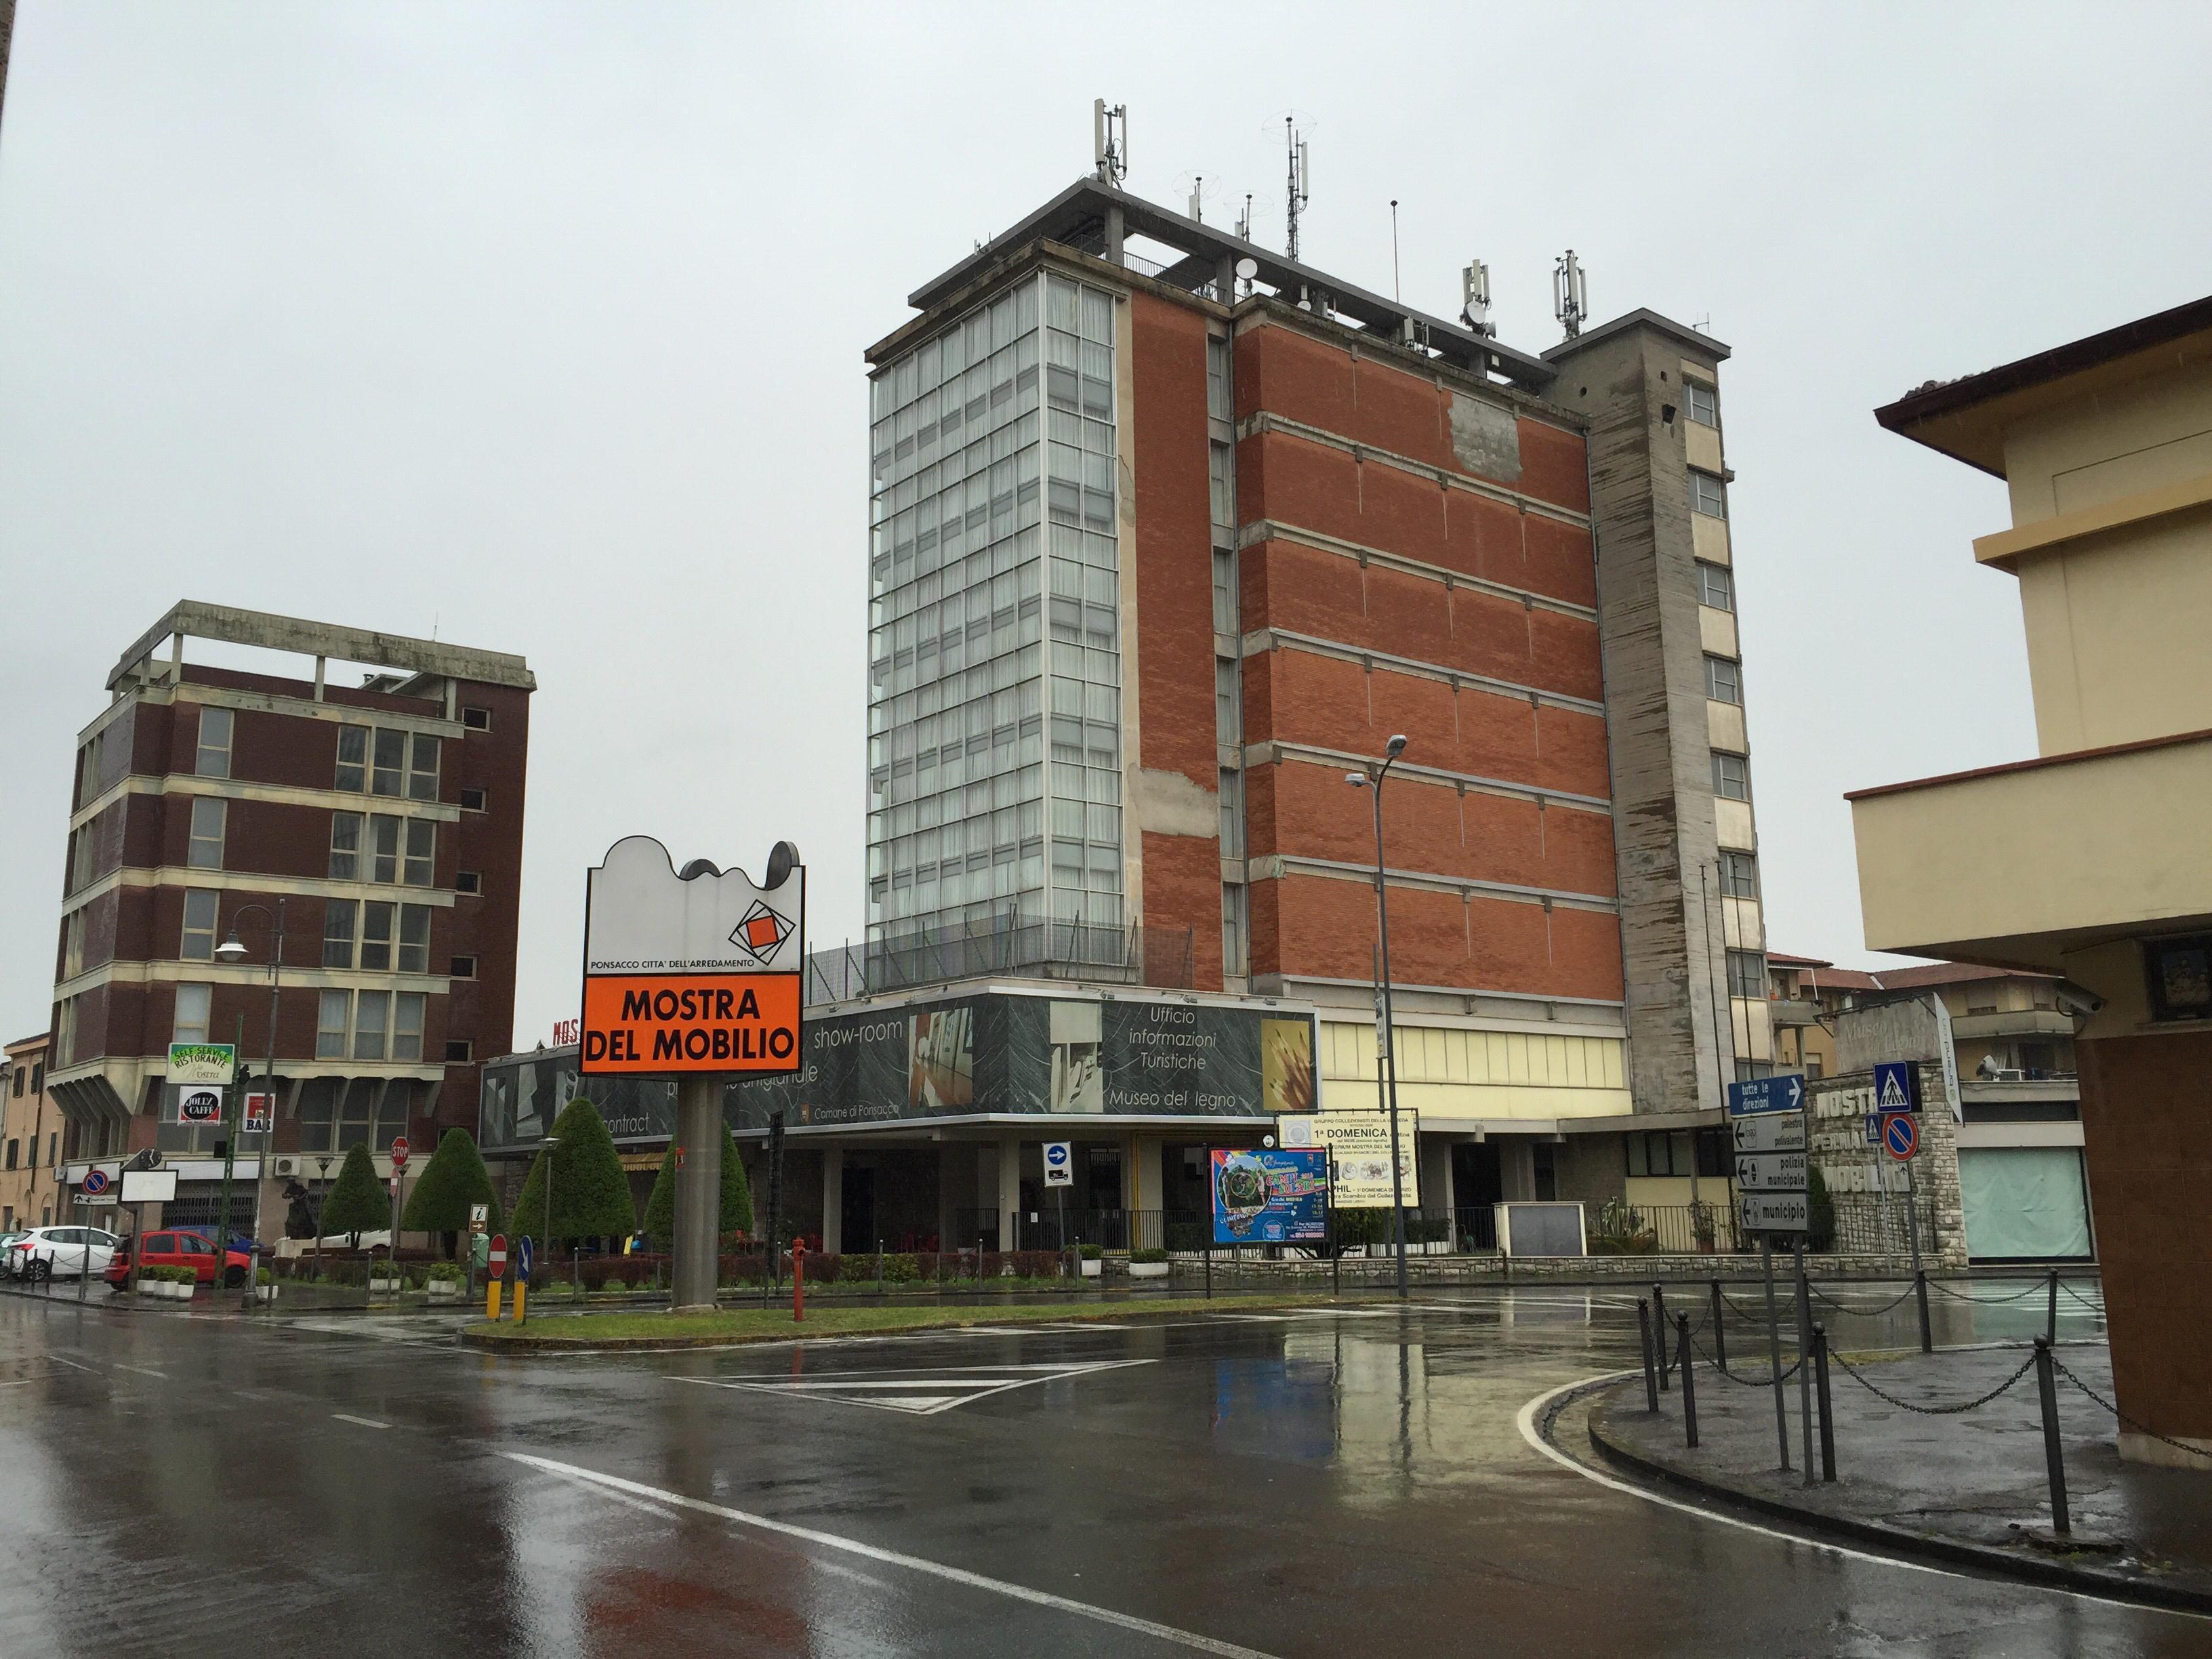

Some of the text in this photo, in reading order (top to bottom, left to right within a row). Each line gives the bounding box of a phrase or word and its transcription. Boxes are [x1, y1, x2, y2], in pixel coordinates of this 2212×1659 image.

[591, 959, 754, 969] PONSACCO CITTA' DELL'ARREDAMENTO
[621, 989, 761, 1021] MOSTRA
[1151, 1006, 1195, 1024] Ufficio
[553, 1019, 579, 1046] MOS
[814, 1021, 903, 1049] show-room
[1129, 1028, 1217, 1047] informazioni
[585, 1027, 794, 1061] DEL MOBILIO
[174, 1047, 229, 1061] SELF SERVICE
[174, 1053, 229, 1069] RISTORANTE
[1141, 1052, 1206, 1070] Turistiche
[1742, 1082, 1769, 1096] tutte le
[186, 1097, 213, 1107] JOLLY
[1109, 1090, 1235, 1111] Museo del legno
[1742, 1096, 1769, 1110] direzioni
[1816, 1086, 1877, 1118] MOSTR
[815, 1103, 899, 1119] Comune di Ponsacco
[602, 1111, 650, 1134] contract
[1781, 1118, 1803, 1131] palestra
[1327, 1128, 1387, 1138] DOMENICA
[1774, 1135, 1803, 1147] polivalente
[393, 1146, 408, 1158] STOP
[1780, 1155, 1805, 1171] polizia
[1767, 1172, 1805, 1187] municipale
[1762, 1201, 1805, 1222] municipio
